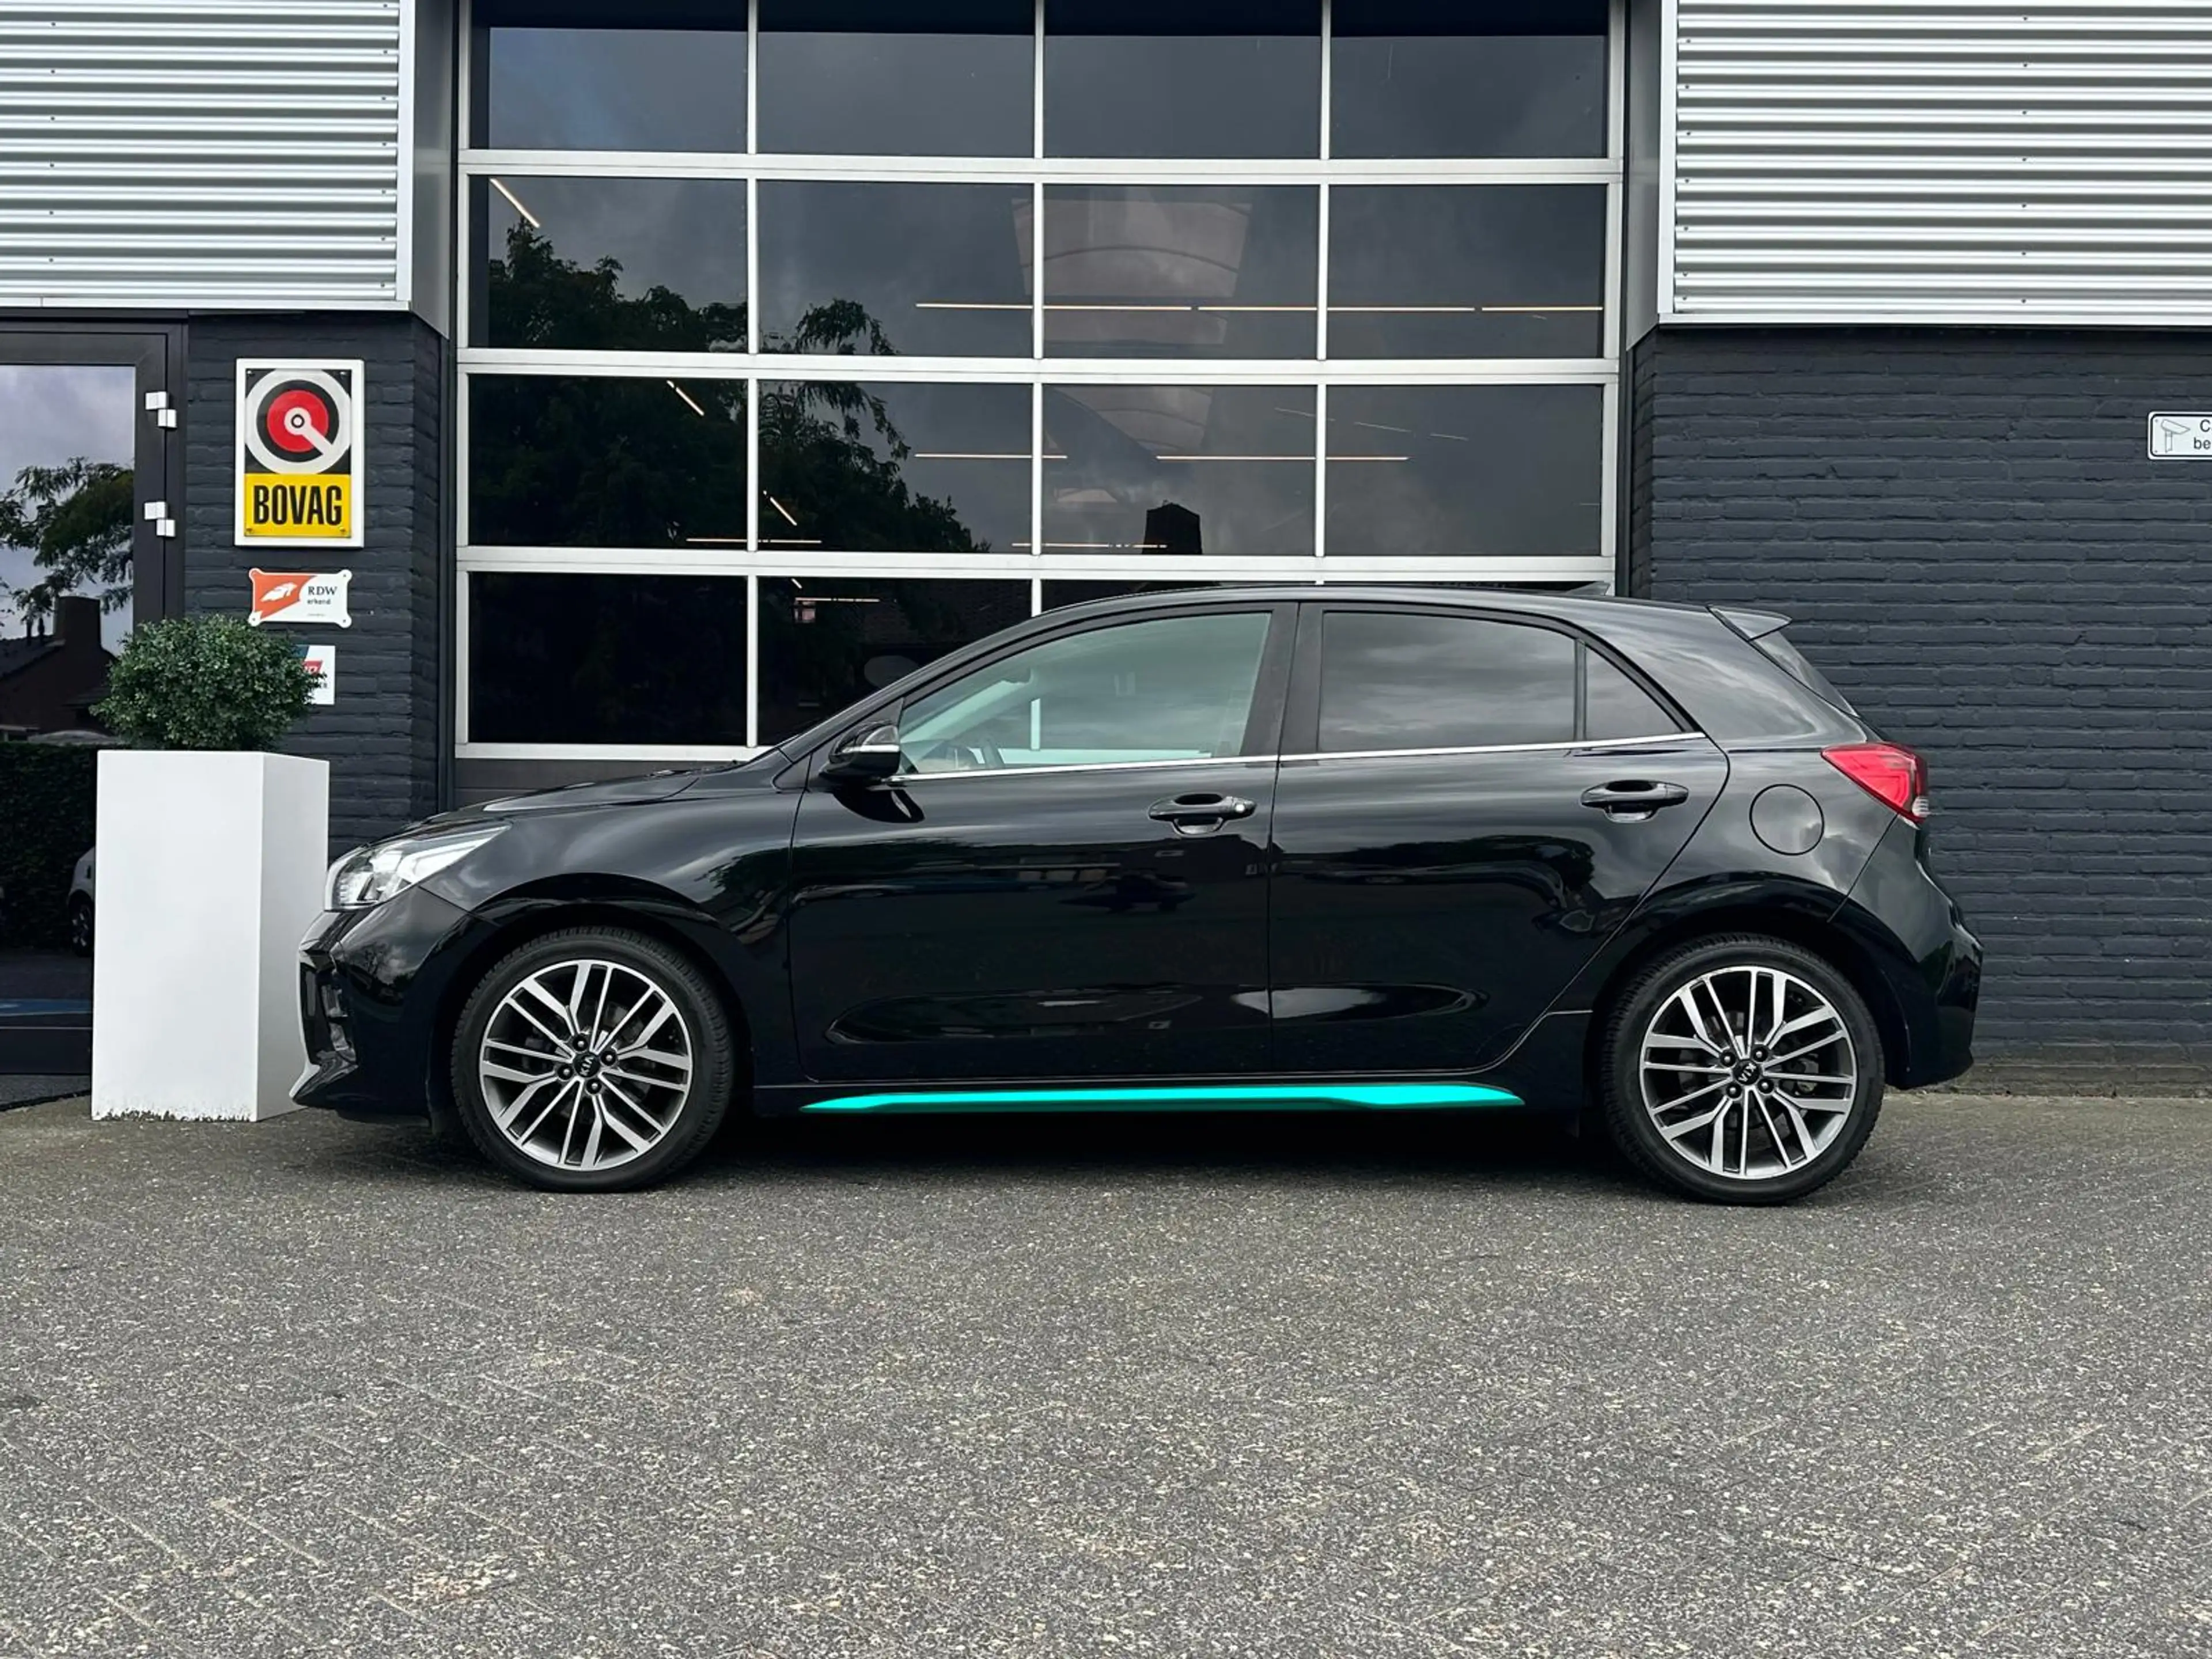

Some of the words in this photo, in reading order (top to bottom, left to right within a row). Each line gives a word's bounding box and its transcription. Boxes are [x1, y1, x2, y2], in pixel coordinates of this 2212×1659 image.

[2200, 419, 2212, 433] C
[253, 484, 342, 526] BOVAG
[308, 586, 338, 595] RDW
[579, 1055, 595, 1076] KIA
[1738, 1062, 1757, 1082] KIA
